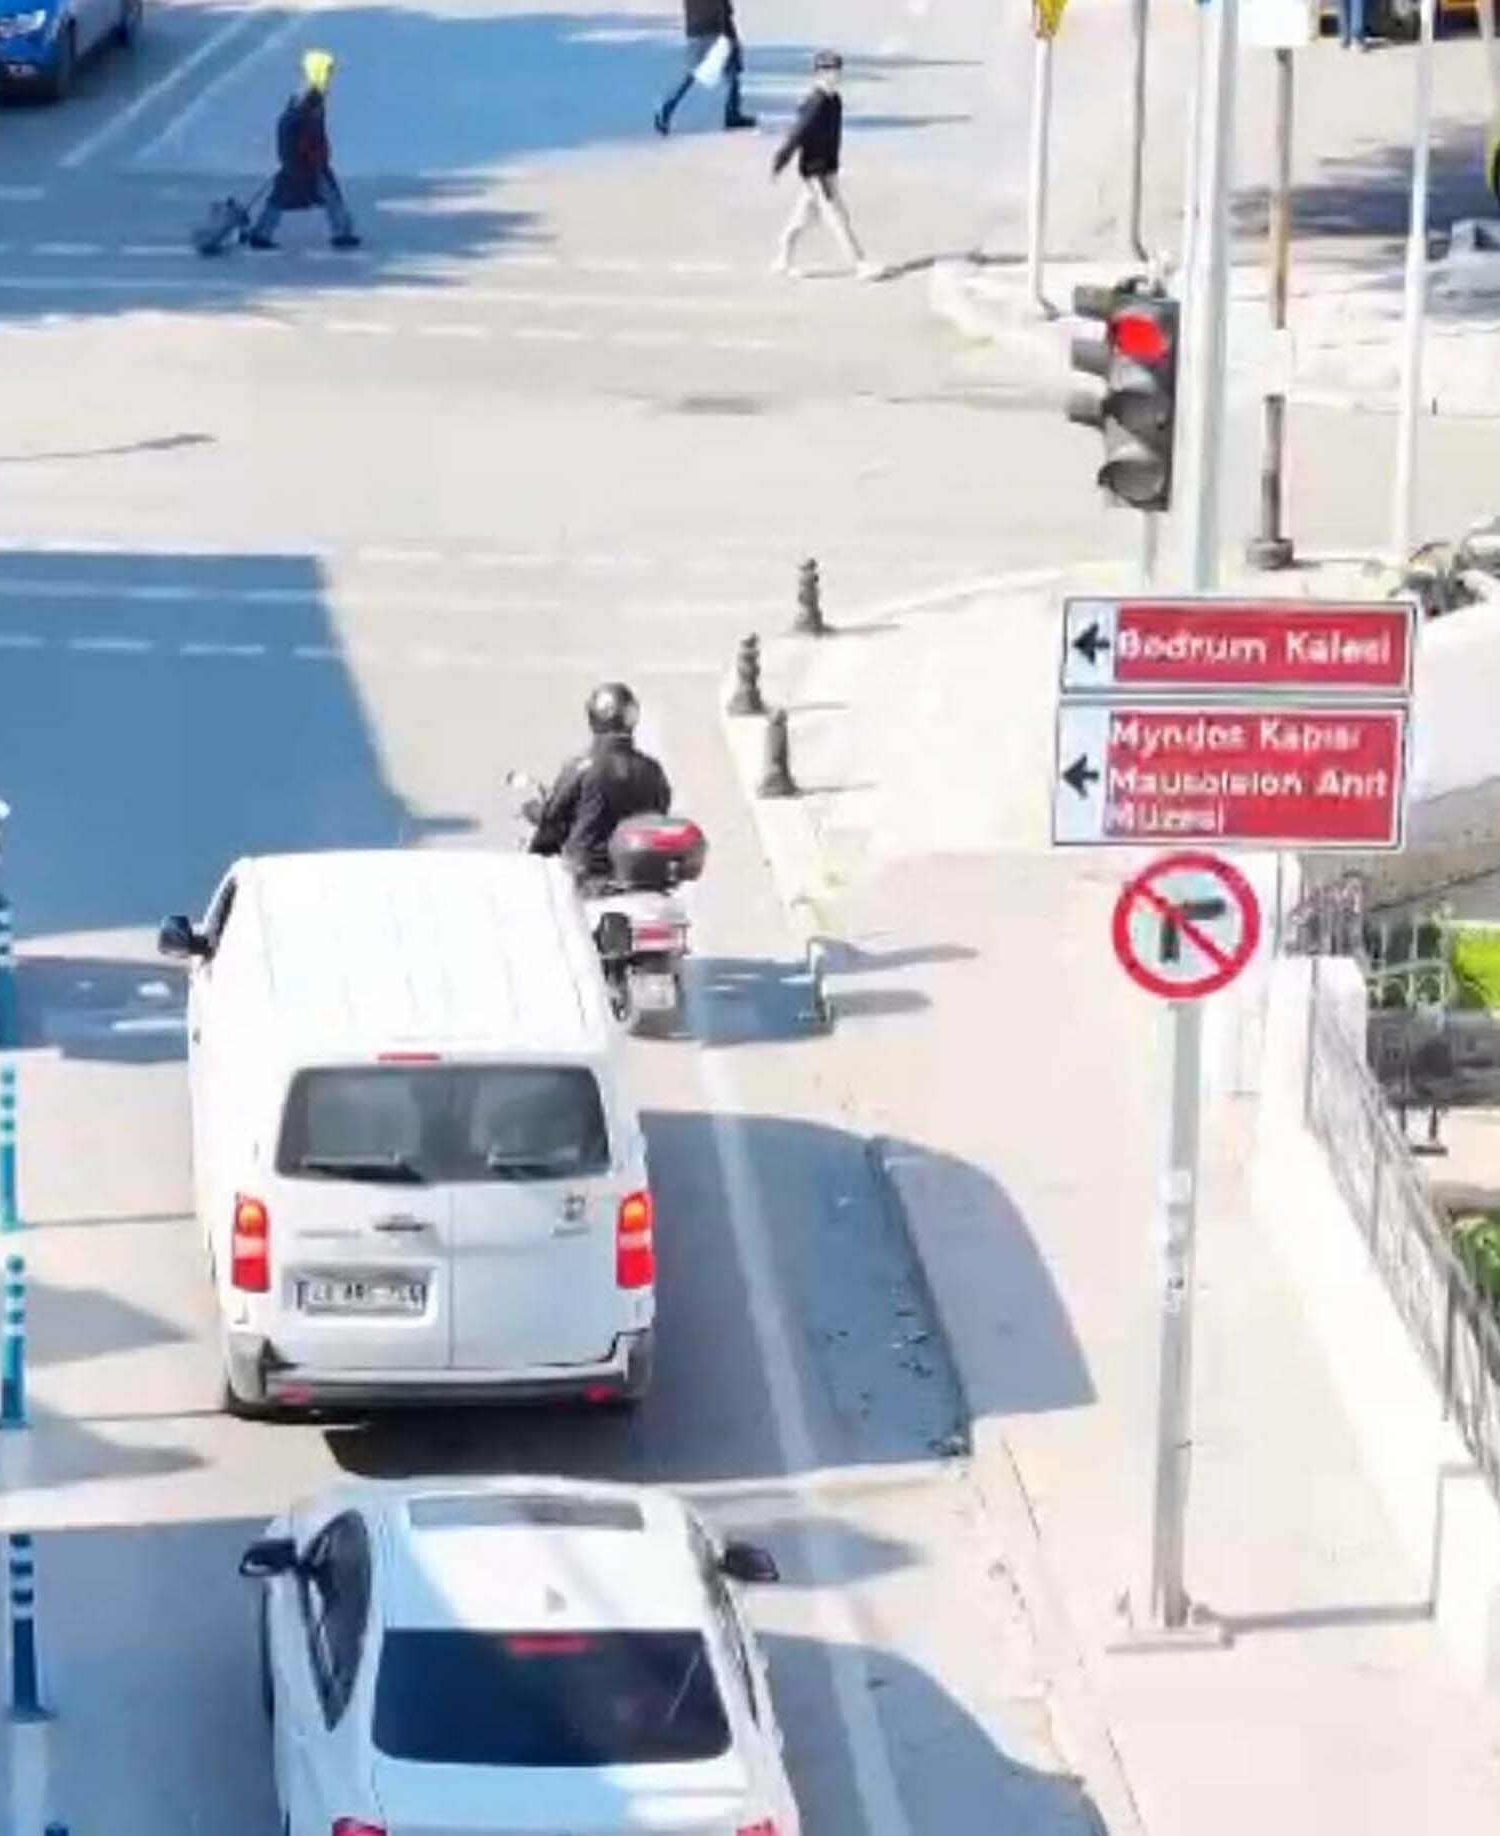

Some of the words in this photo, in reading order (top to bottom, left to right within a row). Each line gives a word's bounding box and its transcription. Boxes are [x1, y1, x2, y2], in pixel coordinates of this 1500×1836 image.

[1118, 628, 1267, 663] Bodrum
[1285, 631, 1391, 664] Kalesi
[1111, 718, 1245, 757] Myndos
